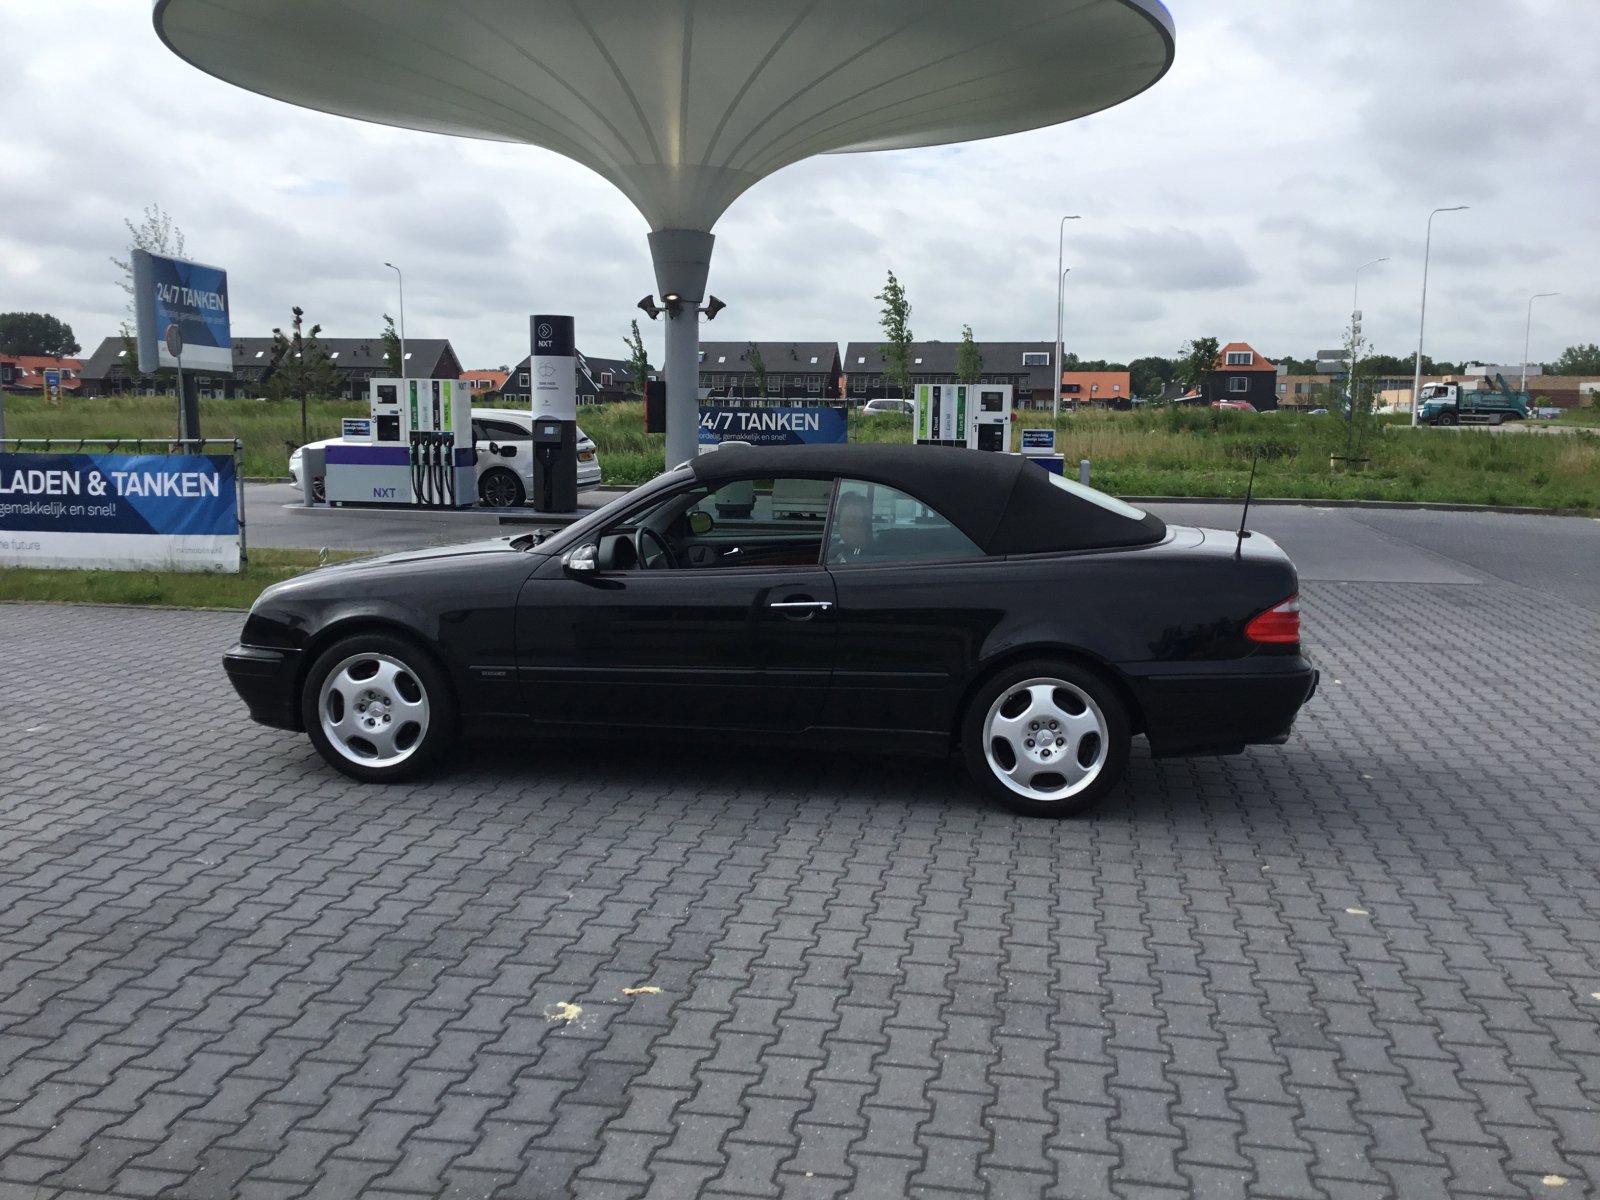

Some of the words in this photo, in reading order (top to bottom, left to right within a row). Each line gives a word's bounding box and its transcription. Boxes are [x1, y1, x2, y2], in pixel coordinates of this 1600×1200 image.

[157, 283, 179, 304] 24/7
[181, 287, 225, 311] TANKEN
[371, 415, 377, 424] 3
[698, 412, 733, 430] 4/7
[737, 412, 819, 431] TANKEN
[973, 424, 977, 433] 1
[723, 432, 760, 442] gemakkelijk
[771, 433, 787, 441] snel!
[0, 469, 81, 495] LADEN
[87, 471, 107, 496] &
[111, 471, 219, 497] TANKEN
[373, 487, 396, 498] NXT
[0, 501, 67, 518] gemakkelijk
[70, 505, 85, 516] en
[87, 503, 116, 517] snel!
[11, 539, 41, 551] future
